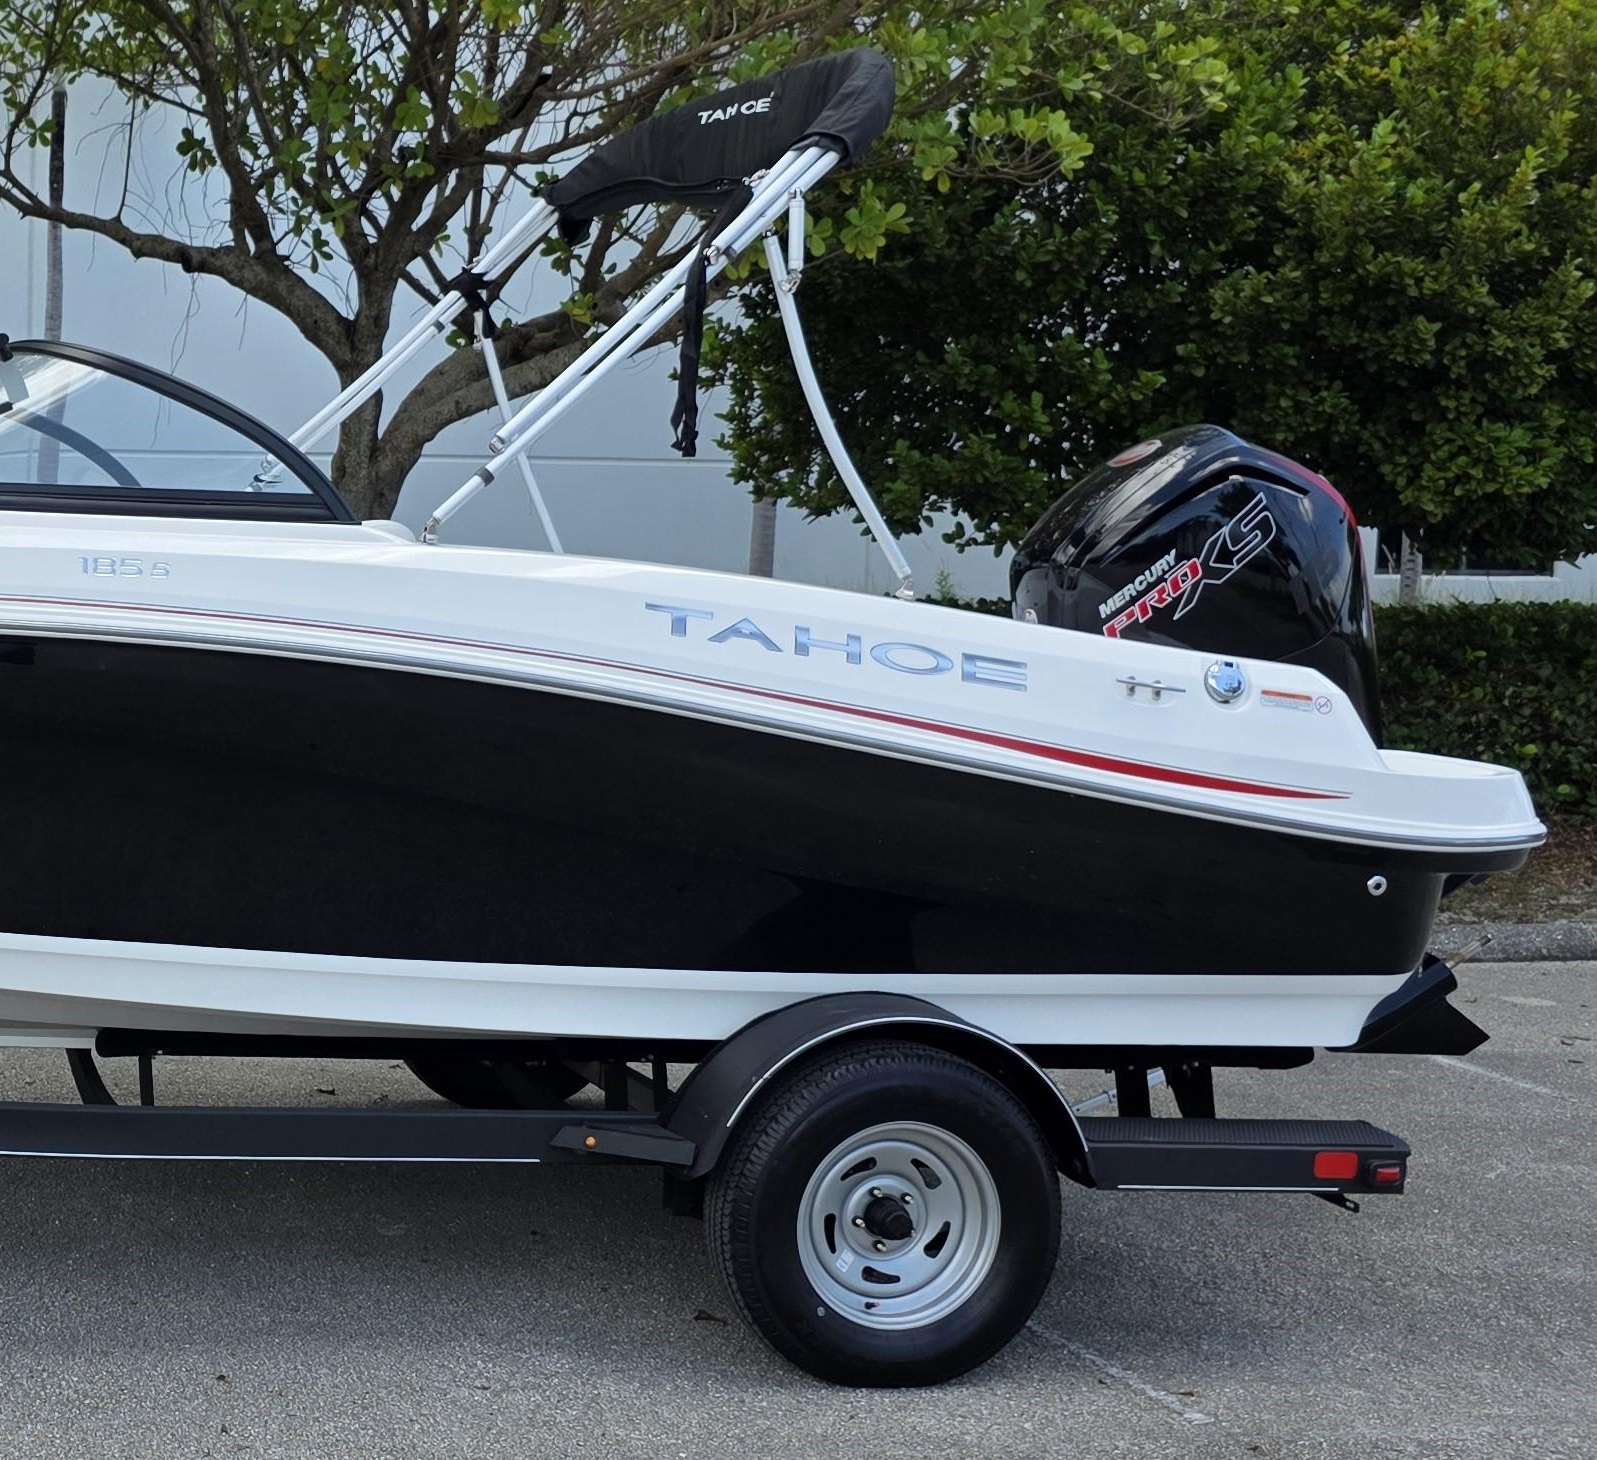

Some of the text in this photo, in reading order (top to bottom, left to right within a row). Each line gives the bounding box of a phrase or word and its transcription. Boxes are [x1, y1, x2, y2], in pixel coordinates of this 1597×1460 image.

[697, 97, 772, 125] TAHOE
[1098, 548, 1177, 619] MERCURY
[1103, 491, 1277, 640] PRO XS
[644, 601, 1028, 692] TAHOE
